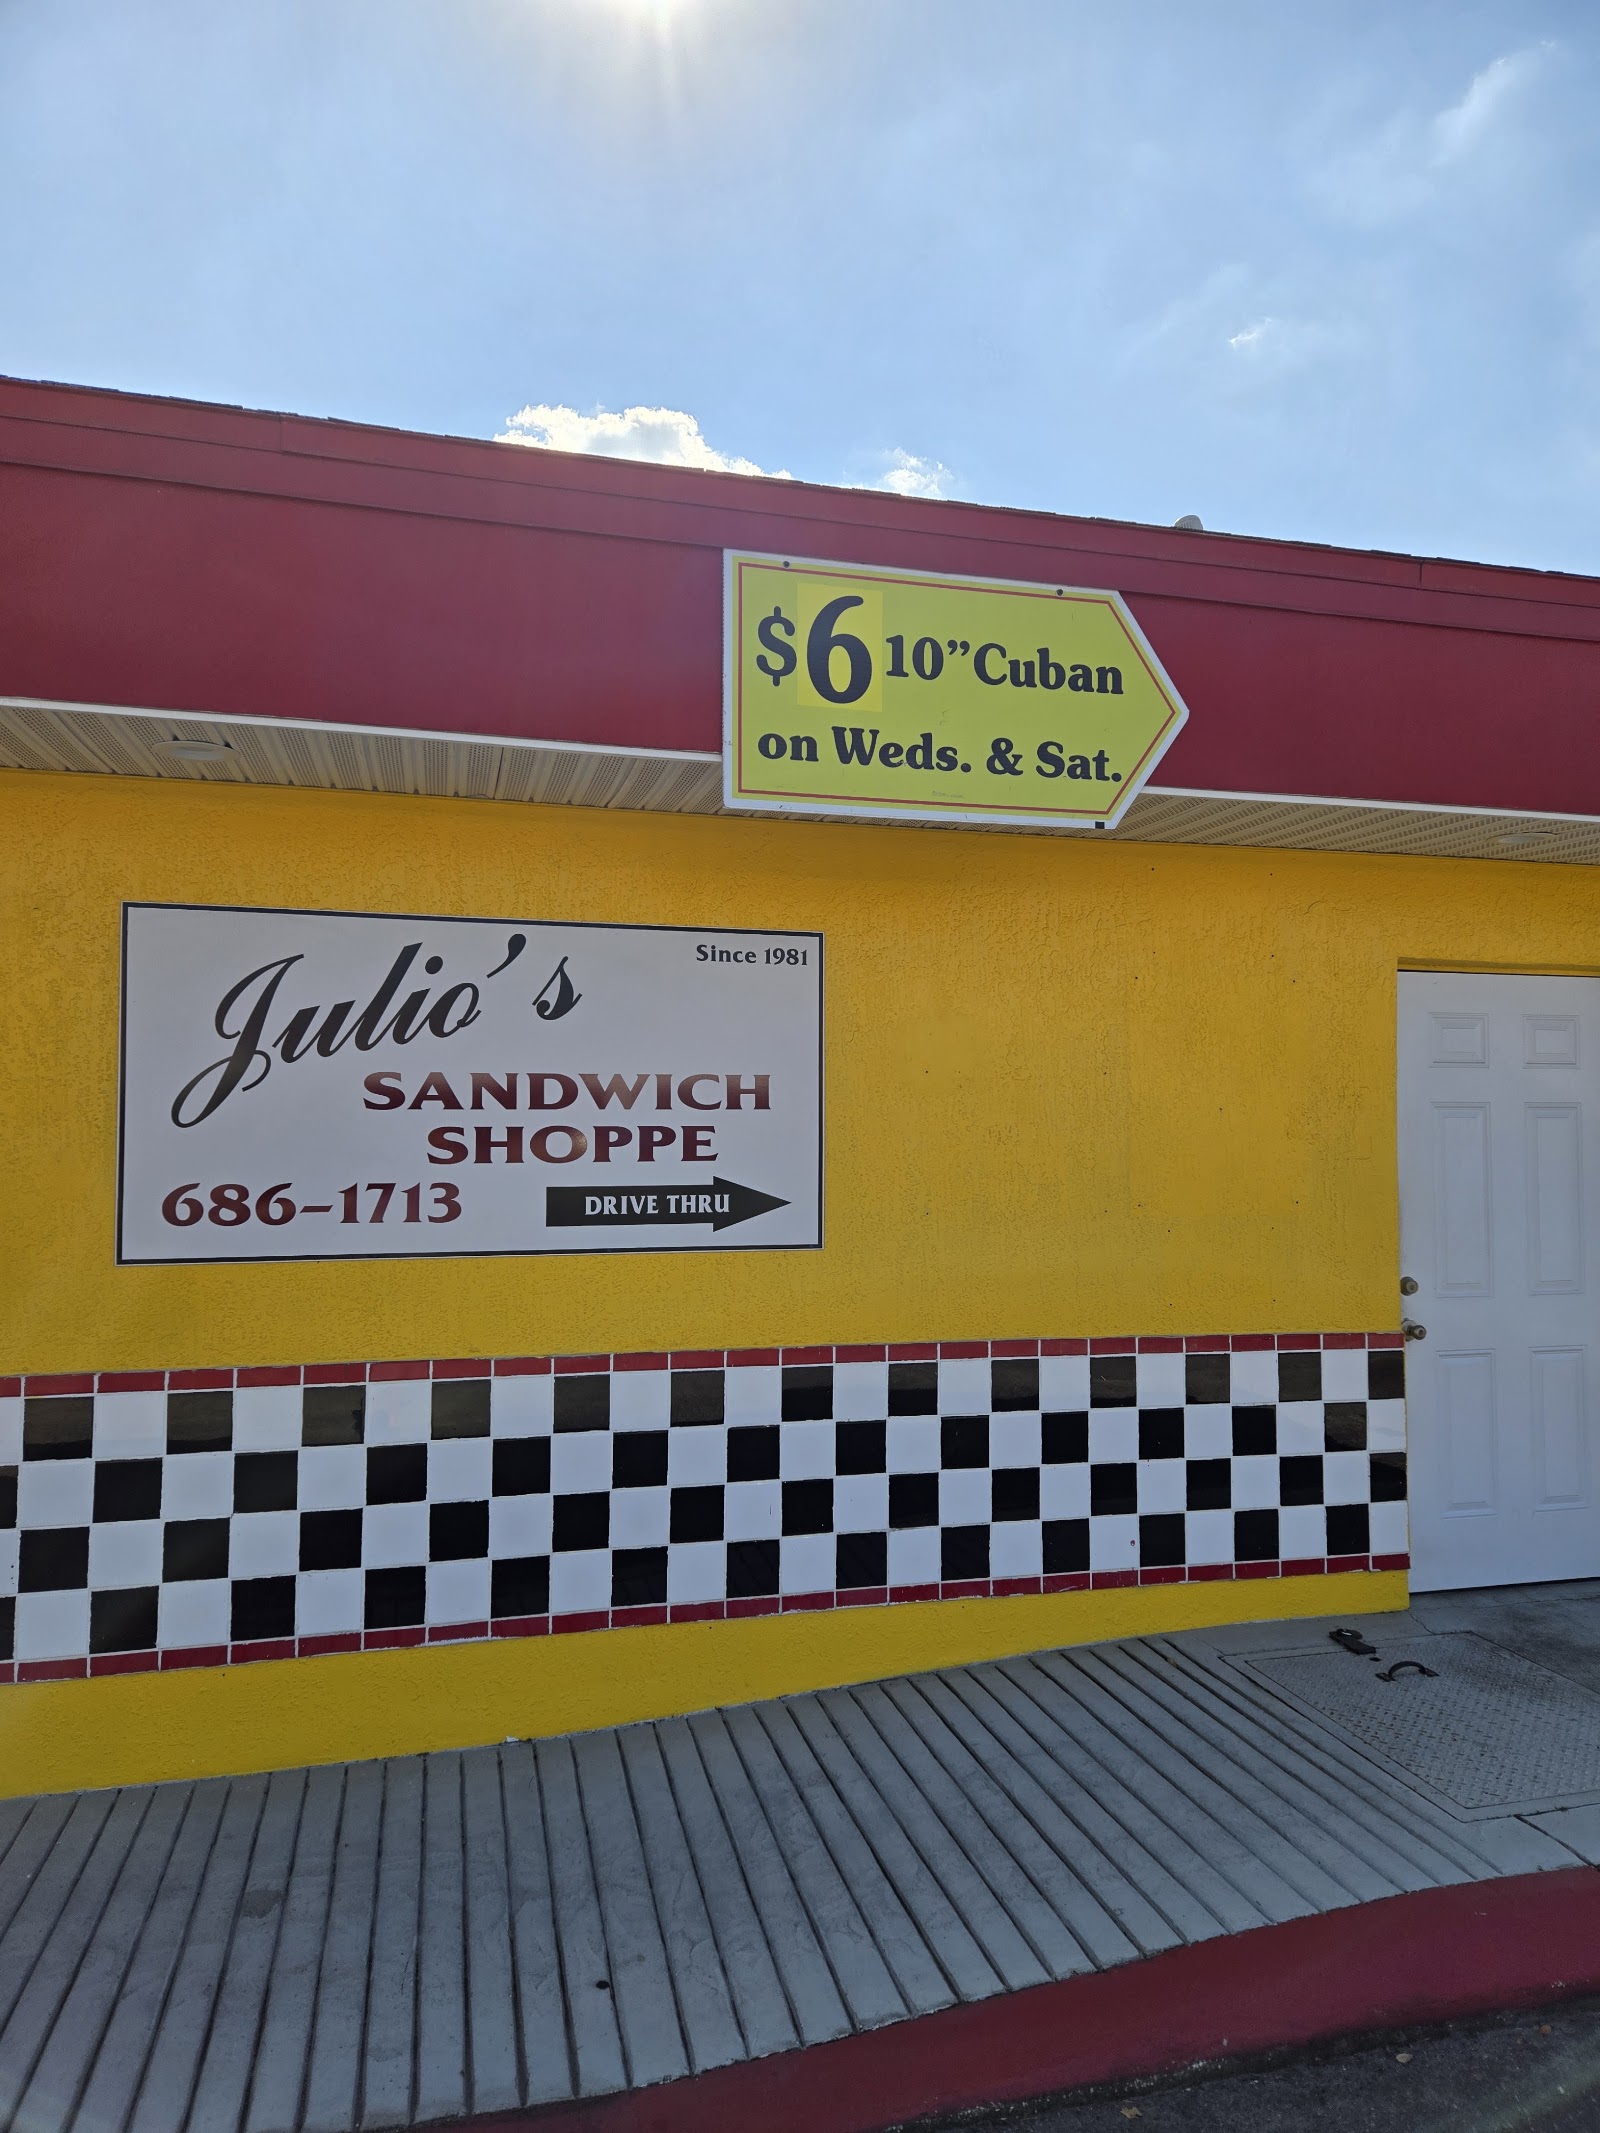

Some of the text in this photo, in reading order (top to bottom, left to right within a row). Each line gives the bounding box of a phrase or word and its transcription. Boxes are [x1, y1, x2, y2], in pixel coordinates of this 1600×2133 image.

[756, 596, 872, 704] $6
[758, 726, 1122, 782] on Weds. & Sat.
[697, 945, 807, 965] Since 1981
[363, 1072, 770, 1110] SANDWICH
[427, 1126, 718, 1164] SHOPPE
[162, 1183, 461, 1226] 686-1713
[585, 1195, 729, 1215] DRIVE THRU
